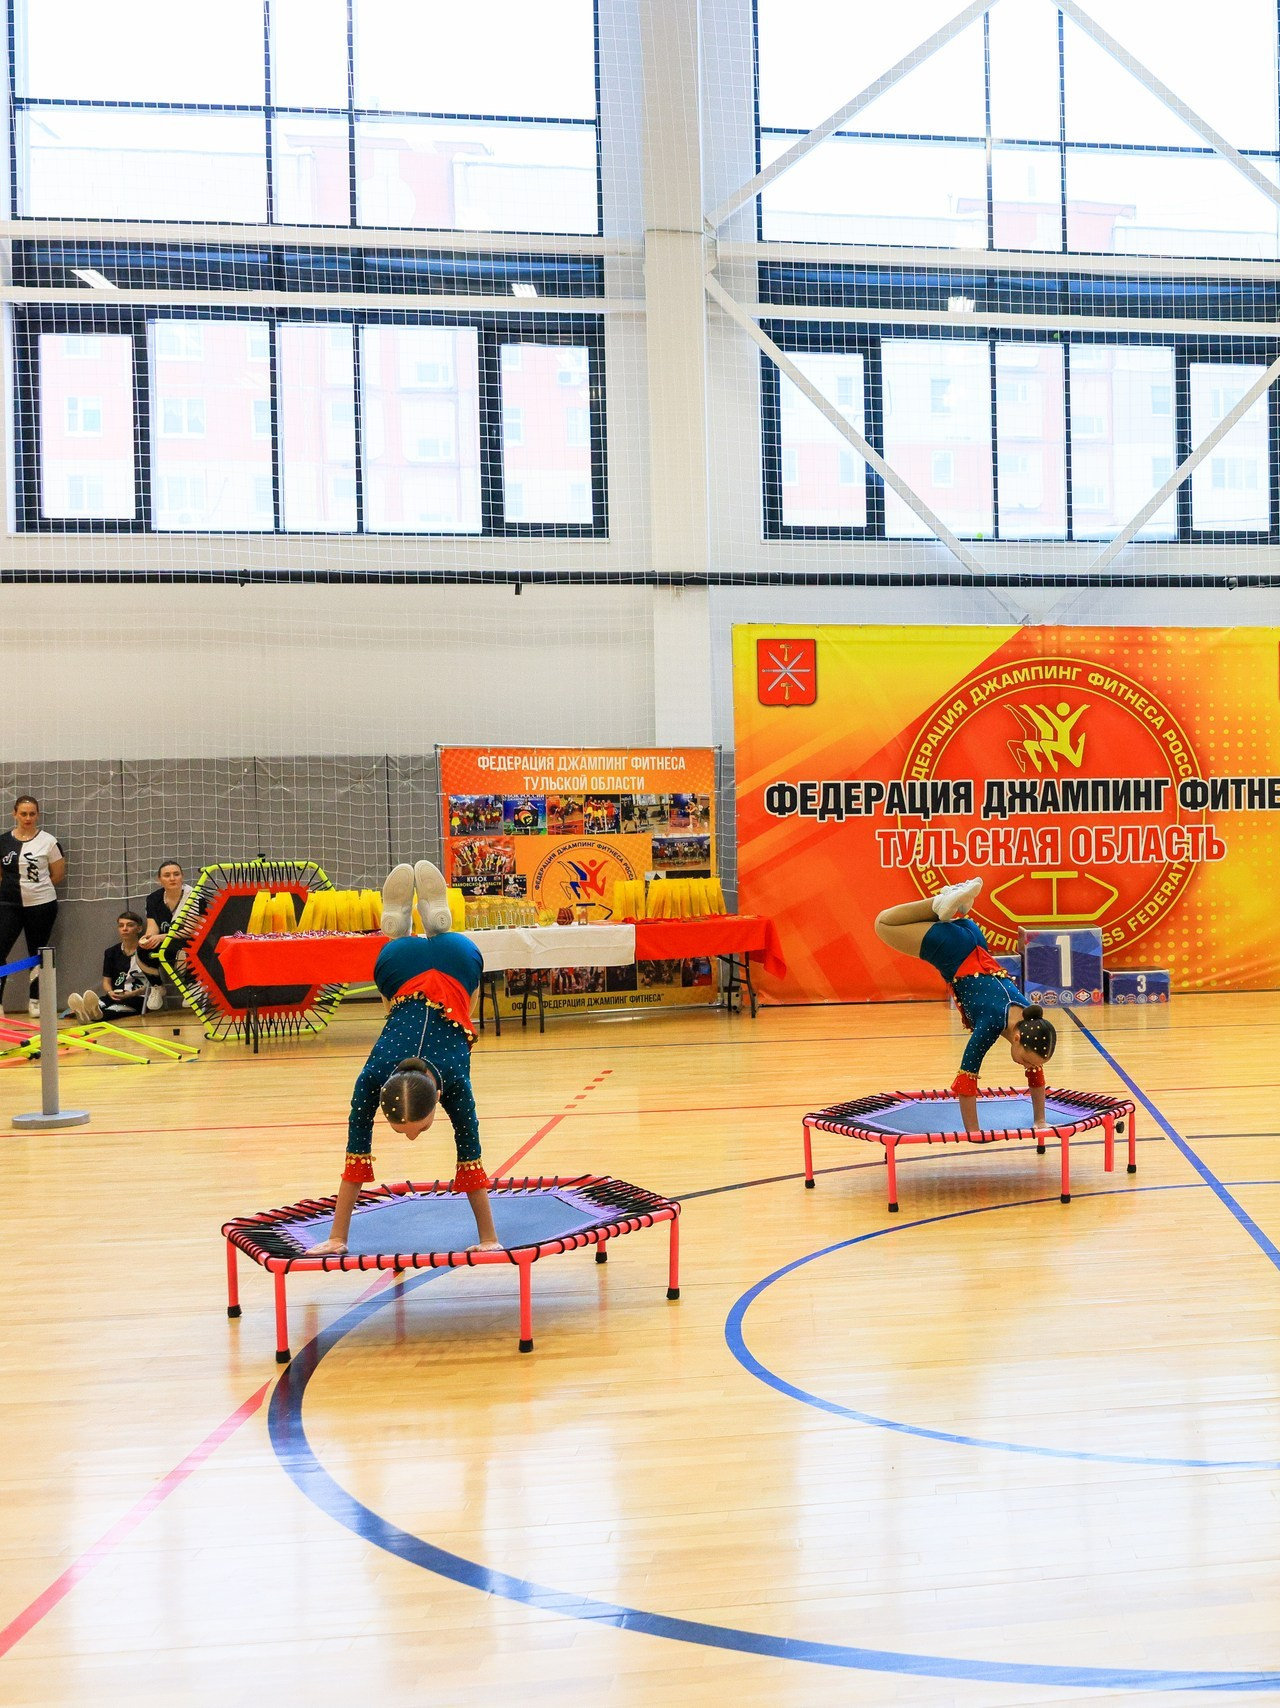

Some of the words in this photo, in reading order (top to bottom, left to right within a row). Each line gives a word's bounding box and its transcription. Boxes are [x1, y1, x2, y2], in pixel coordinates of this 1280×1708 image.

[911, 700, 968, 781] ДЕРАЦИЯ
[969, 665, 1082, 706] ДЖАМПИНГ
[1087, 672, 1165, 731] ФИТНЕСА
[1162, 729, 1194, 779] РОСС
[477, 755, 554, 772] ФЕДЕРАЦИЯ
[557, 755, 628, 772] ДЖАМПИНГ
[631, 755, 686, 771] ФИТНЕСА
[523, 774, 588, 792] ТУЛЬСКОЙ
[590, 776, 645, 791] ОБЛАСТИ
[765, 779, 975, 823] ФЕДЕРАЦИЯ
[981, 778, 1171, 821] ДЖАМПИНГ
[23, 851, 40, 883] JAZZ
[534, 853, 557, 890] ФЕДЕРАЦИЯ
[556, 842, 596, 856] ДЖАМПИНГ
[597, 843, 624, 863] ФИТНЕСА
[623, 862, 634, 880] РОСС
[875, 827, 1061, 868] ТУЛЬСКАЯ
[1069, 824, 1227, 865] ОБЛАСТЬ
[1127, 859, 1187, 932] FEDERAT
[1055, 935, 1073, 987] 1
[587, 995, 628, 1007] ДЖАМПИНГ
[629, 993, 665, 1004] ФИТНЕСА"
[1136, 974, 1147, 993] 3
